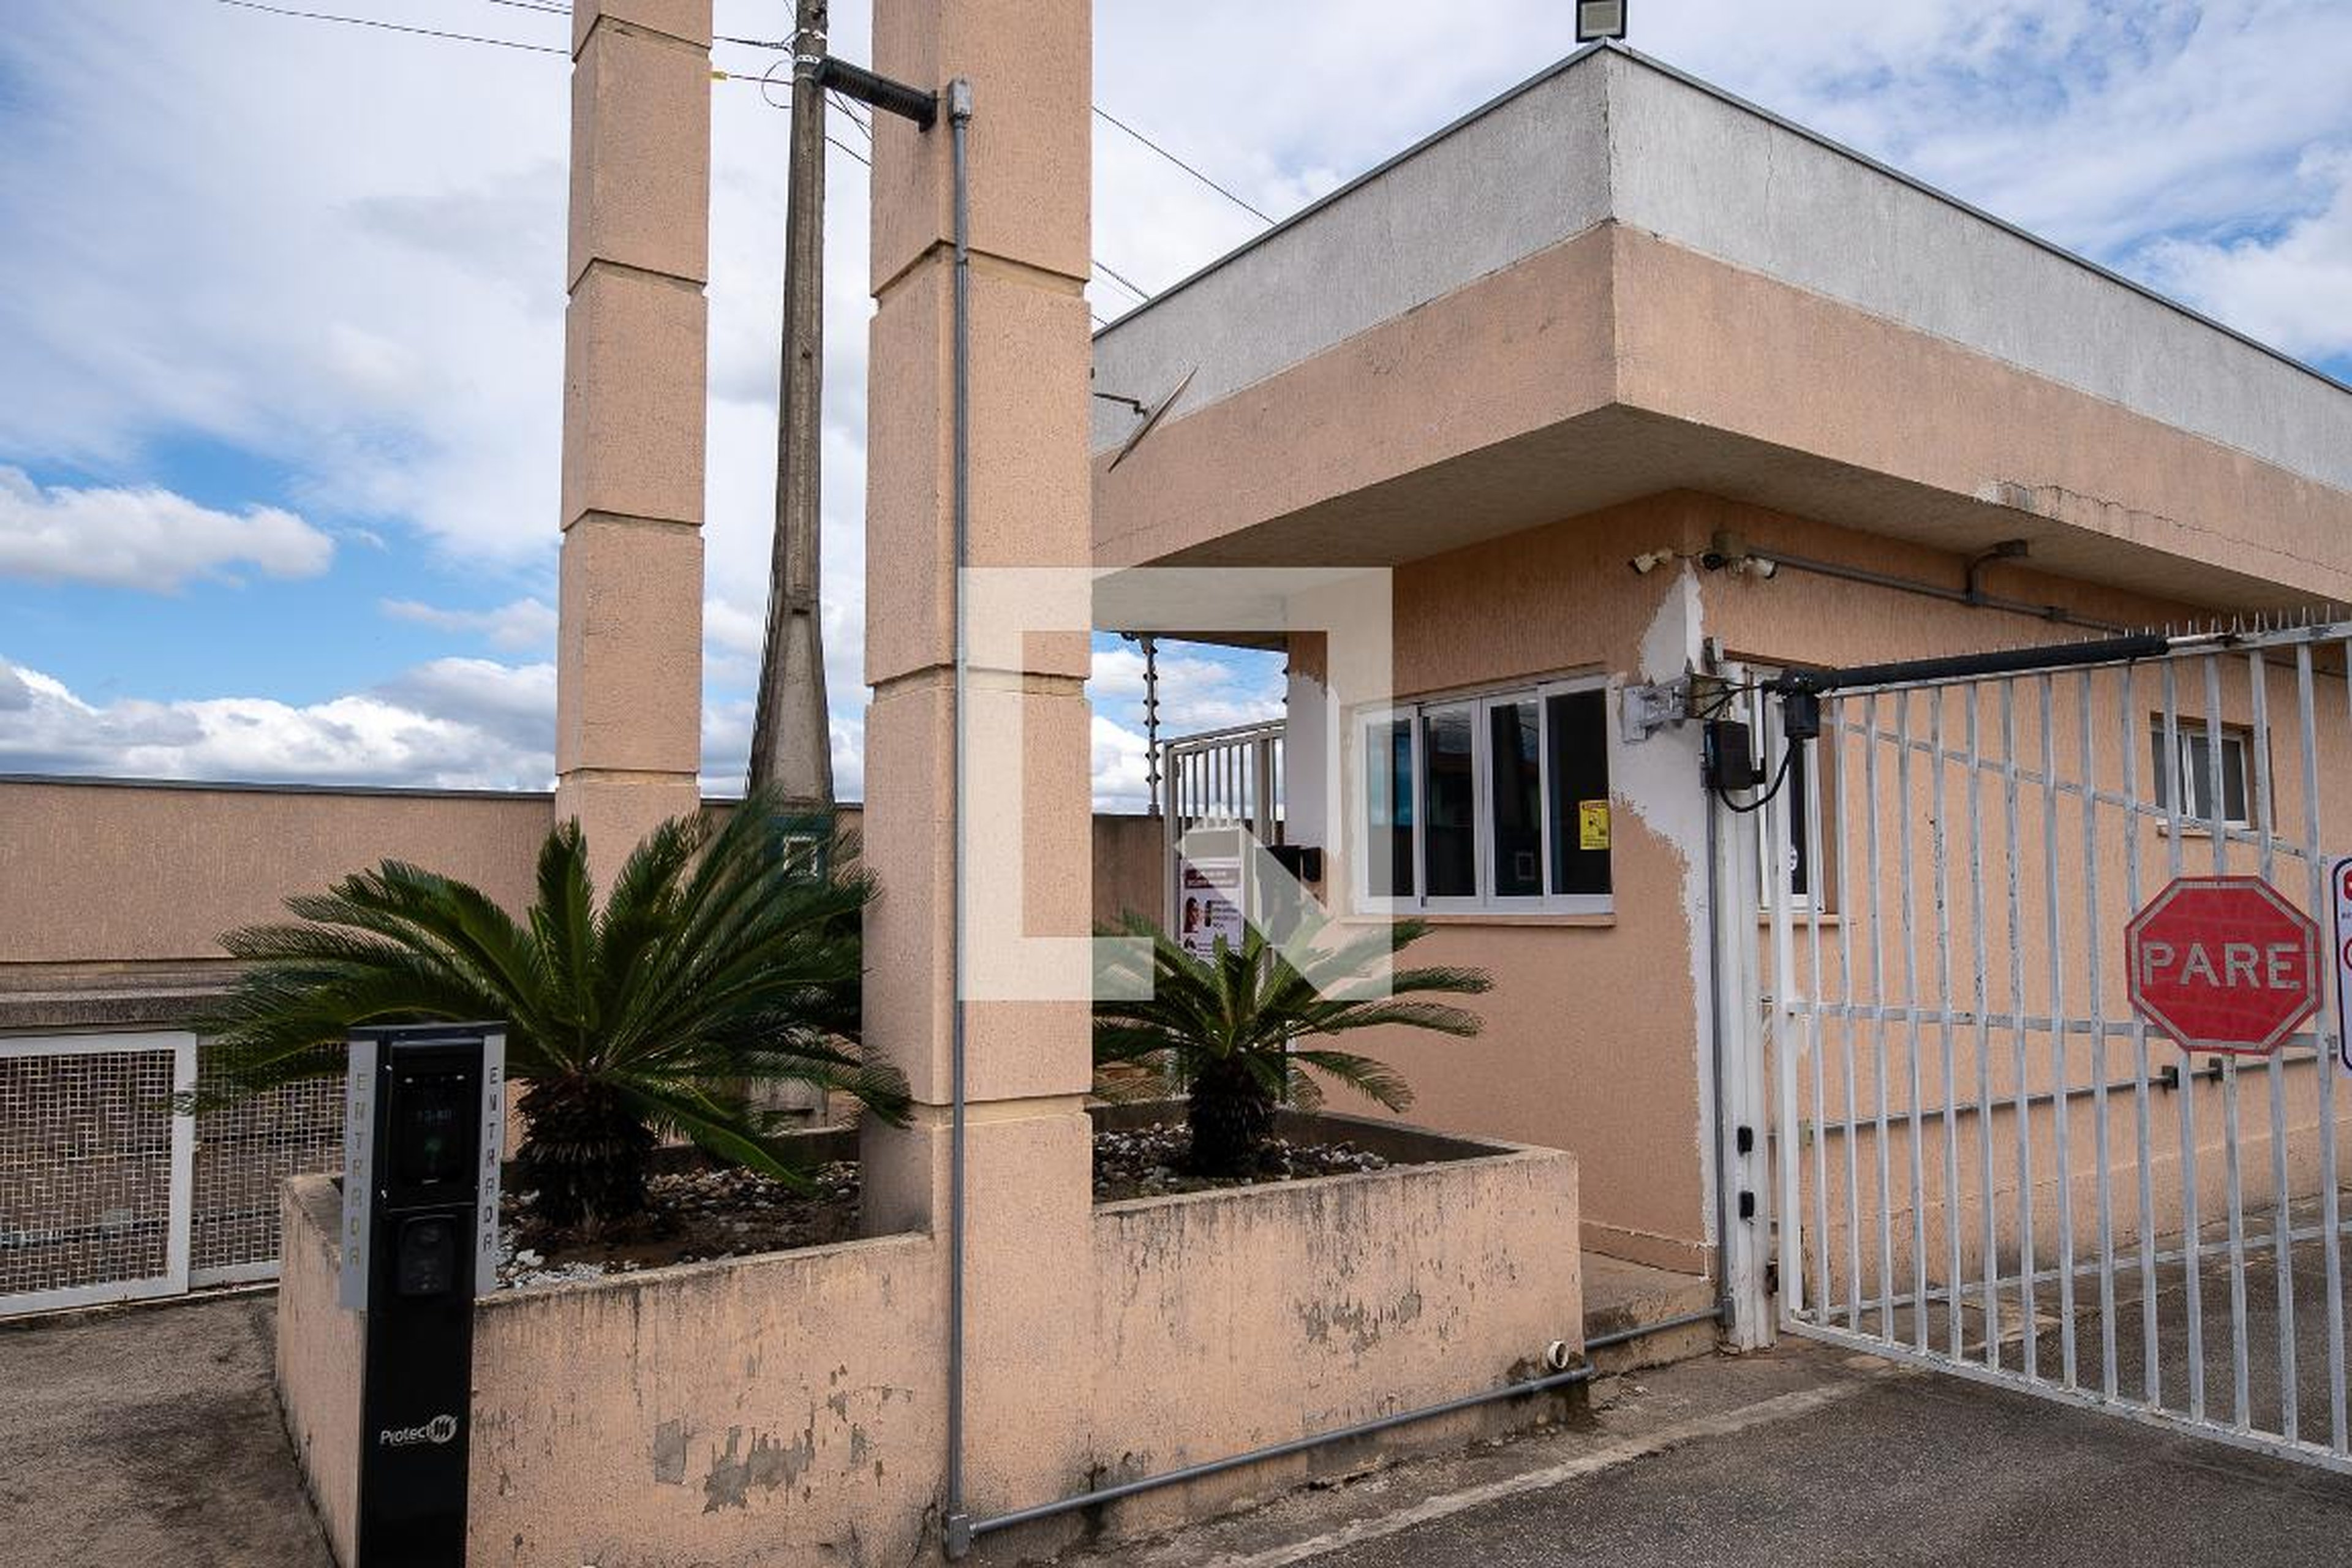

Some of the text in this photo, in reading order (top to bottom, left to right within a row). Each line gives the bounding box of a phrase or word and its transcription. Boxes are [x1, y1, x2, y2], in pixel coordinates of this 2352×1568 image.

[2143, 942, 2301, 989] PARE
[350, 1072, 368, 1265] ENTRADA
[484, 1067, 498, 1251] ENTRADA
